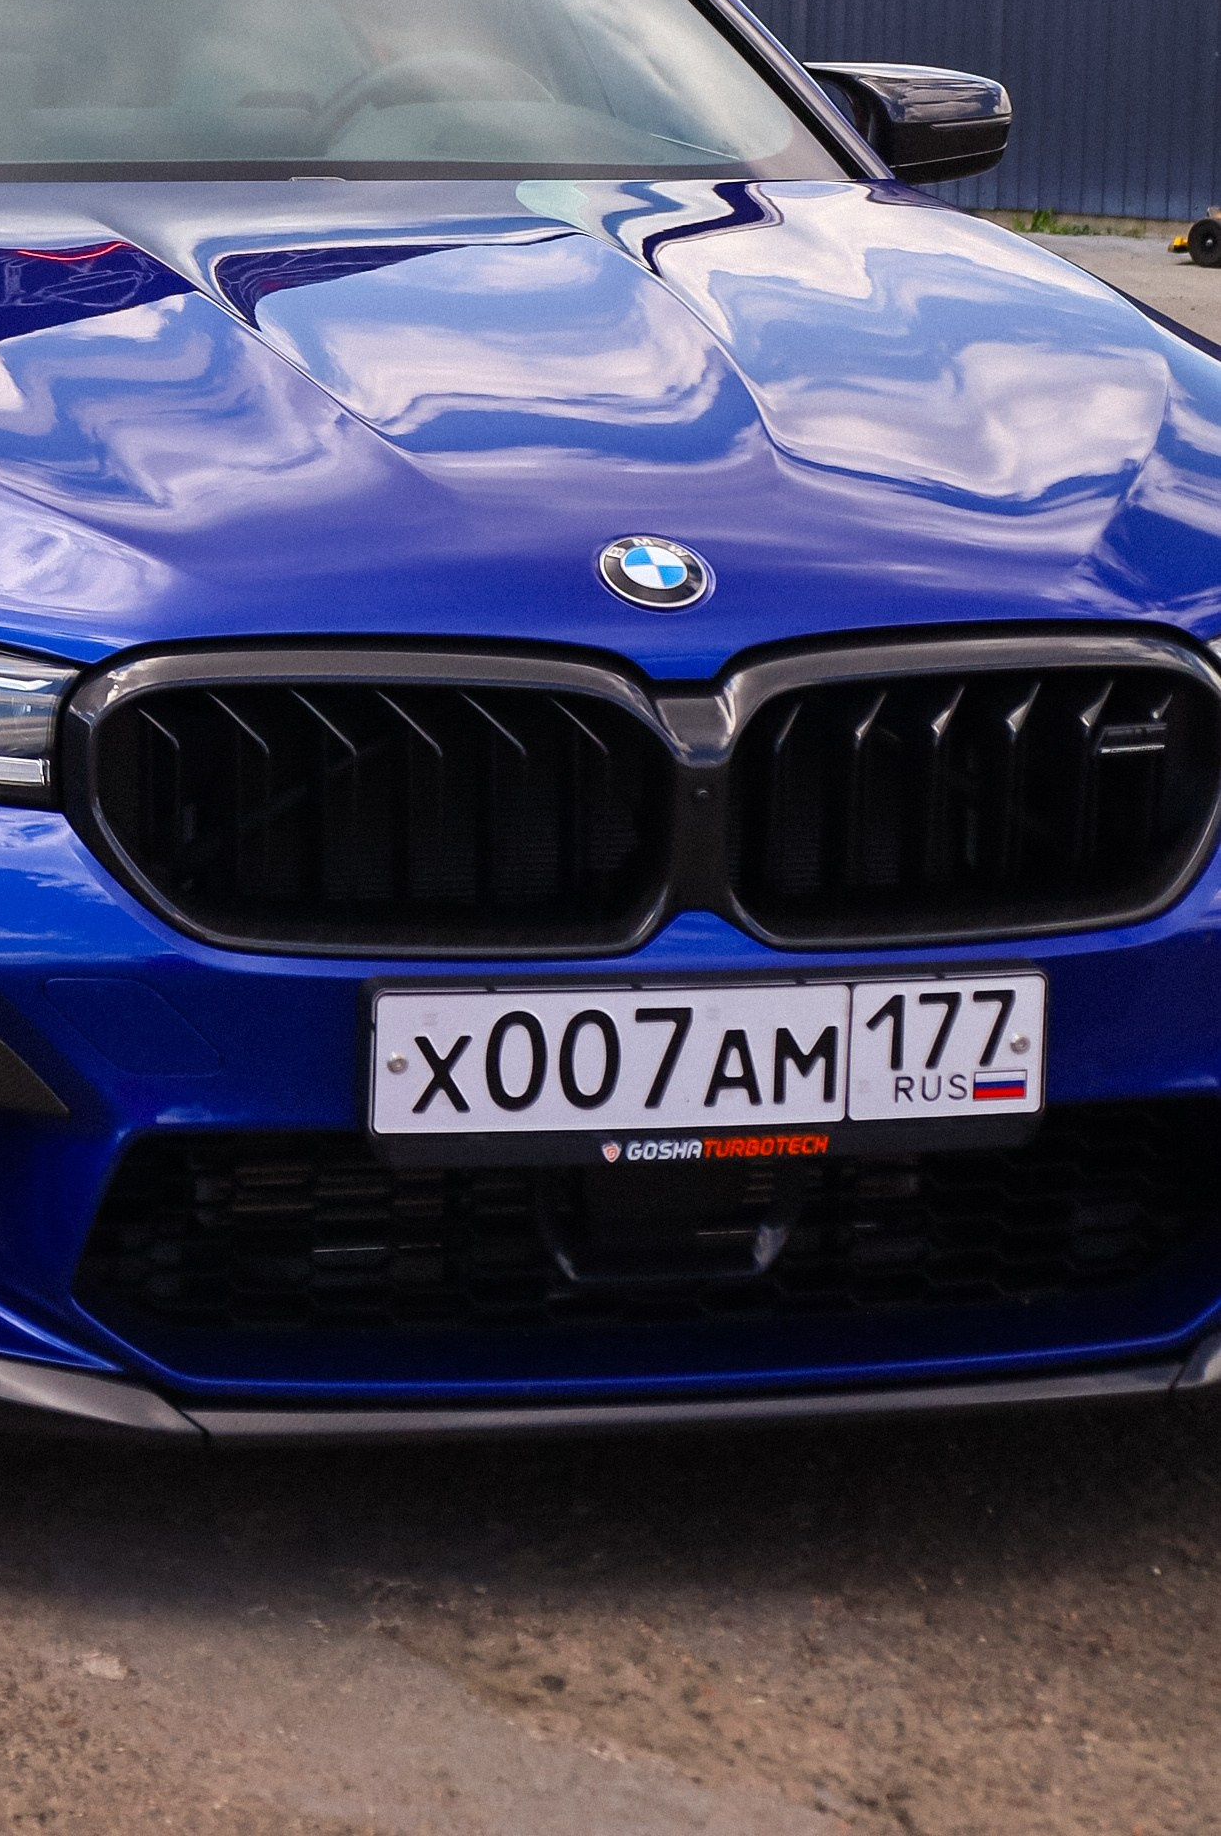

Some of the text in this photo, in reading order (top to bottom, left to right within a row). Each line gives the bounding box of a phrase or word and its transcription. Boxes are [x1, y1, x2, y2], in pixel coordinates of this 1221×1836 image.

[606, 537, 689, 558] BMW
[411, 990, 1017, 1114] X007AM 177
[895, 1074, 968, 1103] RUS
